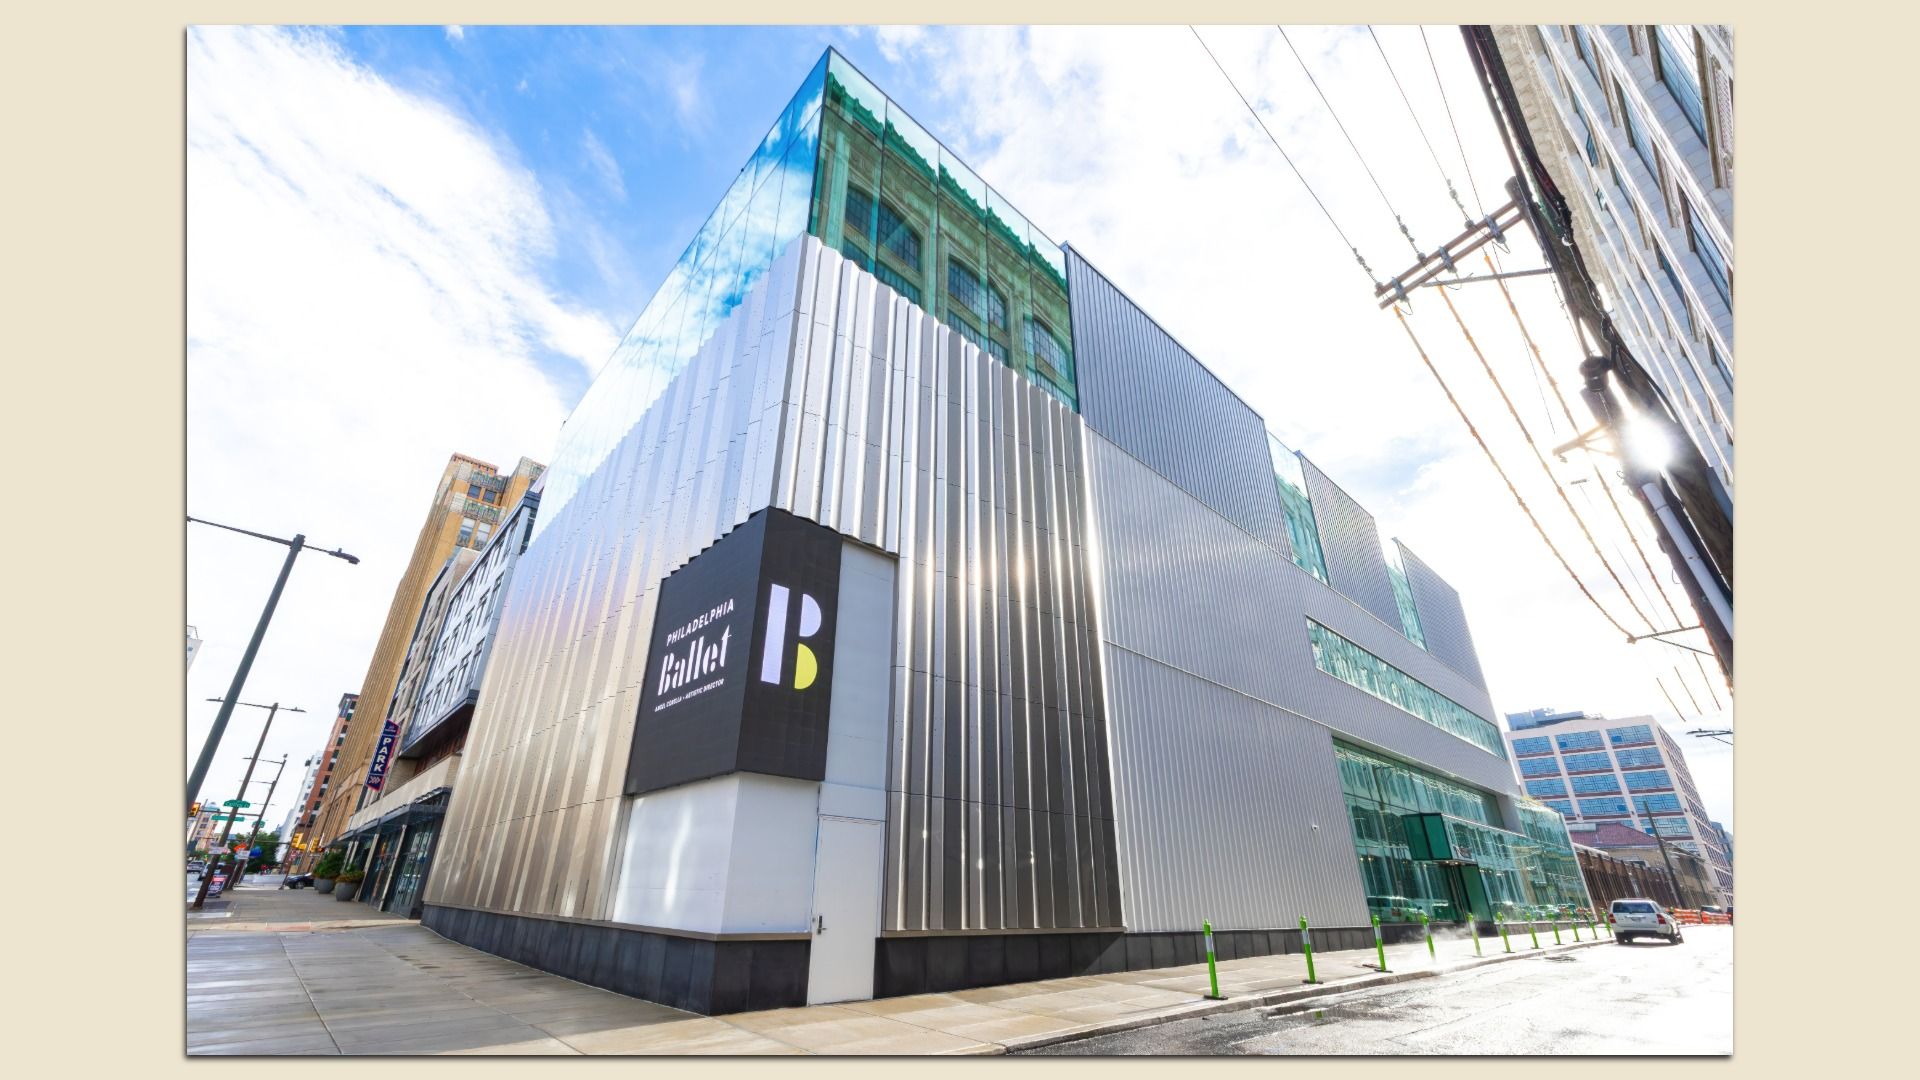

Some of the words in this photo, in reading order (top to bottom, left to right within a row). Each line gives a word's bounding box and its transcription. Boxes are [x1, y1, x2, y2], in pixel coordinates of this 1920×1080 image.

[666, 598, 734, 647] PHILADELPHIA
[761, 583, 822, 690] B
[657, 624, 732, 697] Ballet
[373, 737, 392, 772] PARK
